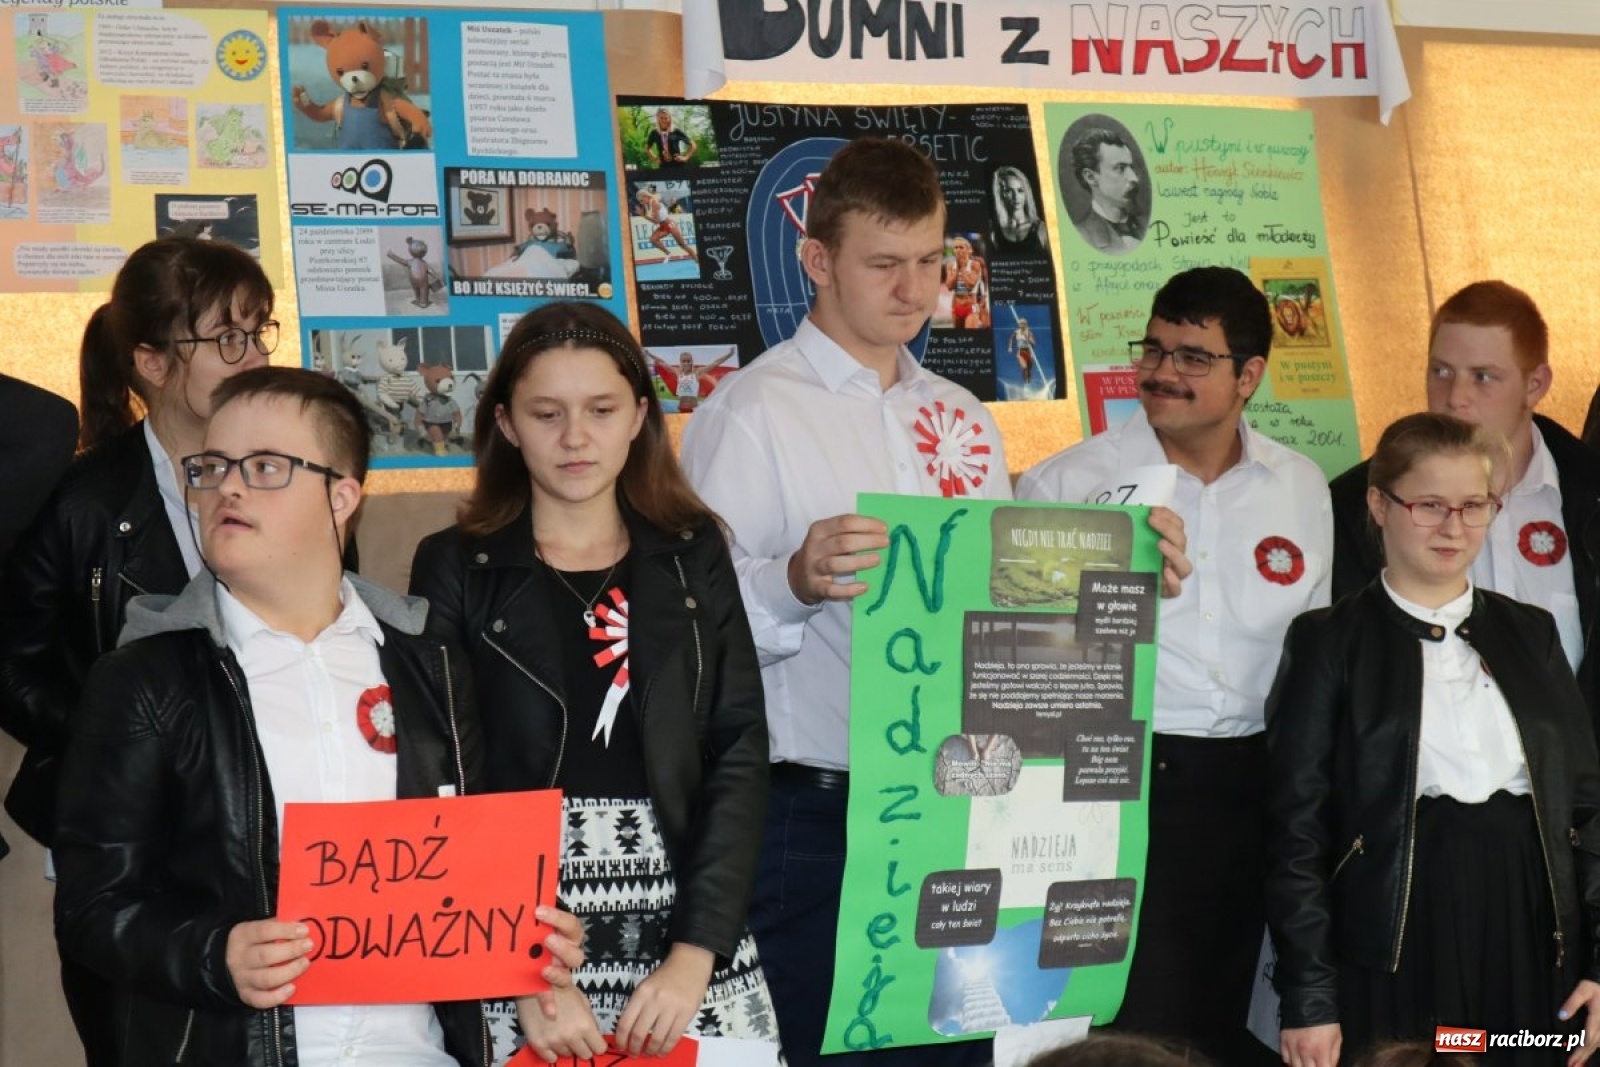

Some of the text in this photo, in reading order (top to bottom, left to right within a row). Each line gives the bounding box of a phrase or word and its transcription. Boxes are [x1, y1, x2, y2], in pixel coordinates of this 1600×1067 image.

[729, 104, 841, 141] JUSTYNA
[887, 134, 989, 162] RSETIC
[460, 169, 589, 186] PORA NA DOBRANOC
[291, 203, 438, 216] SE-MA-FOR
[1222, 211, 1236, 222] to
[1227, 228, 1246, 243] dla
[453, 281, 471, 294] BO
[474, 279, 492, 295] JUŻ
[496, 280, 544, 297] KSIĘŻYĆ
[1294, 361, 1333, 371] pustyni
[1298, 374, 1336, 383] puszczy
[1011, 528, 1111, 550] NIGDY NIE TRAĆ NADZIEI
[1092, 582, 1145, 594] Może masz
[1097, 600, 1138, 613] w głowie
[972, 672, 1020, 680] funkcjonować
[1001, 682, 1024, 691] gotowi
[1026, 682, 1051, 690] walczyć
[1060, 682, 1079, 690] lepsze
[1001, 692, 1040, 701] poddajemy
[992, 702, 1023, 711] Nadzieja
[1011, 833, 1076, 859] NADZIEJA
[305, 815, 449, 893] BĄDŹ
[1011, 861, 1072, 873] ma sens
[931, 882, 992, 896] takiej wiary
[941, 901, 976, 912] w ludzi
[931, 920, 982, 931] cały ten świat
